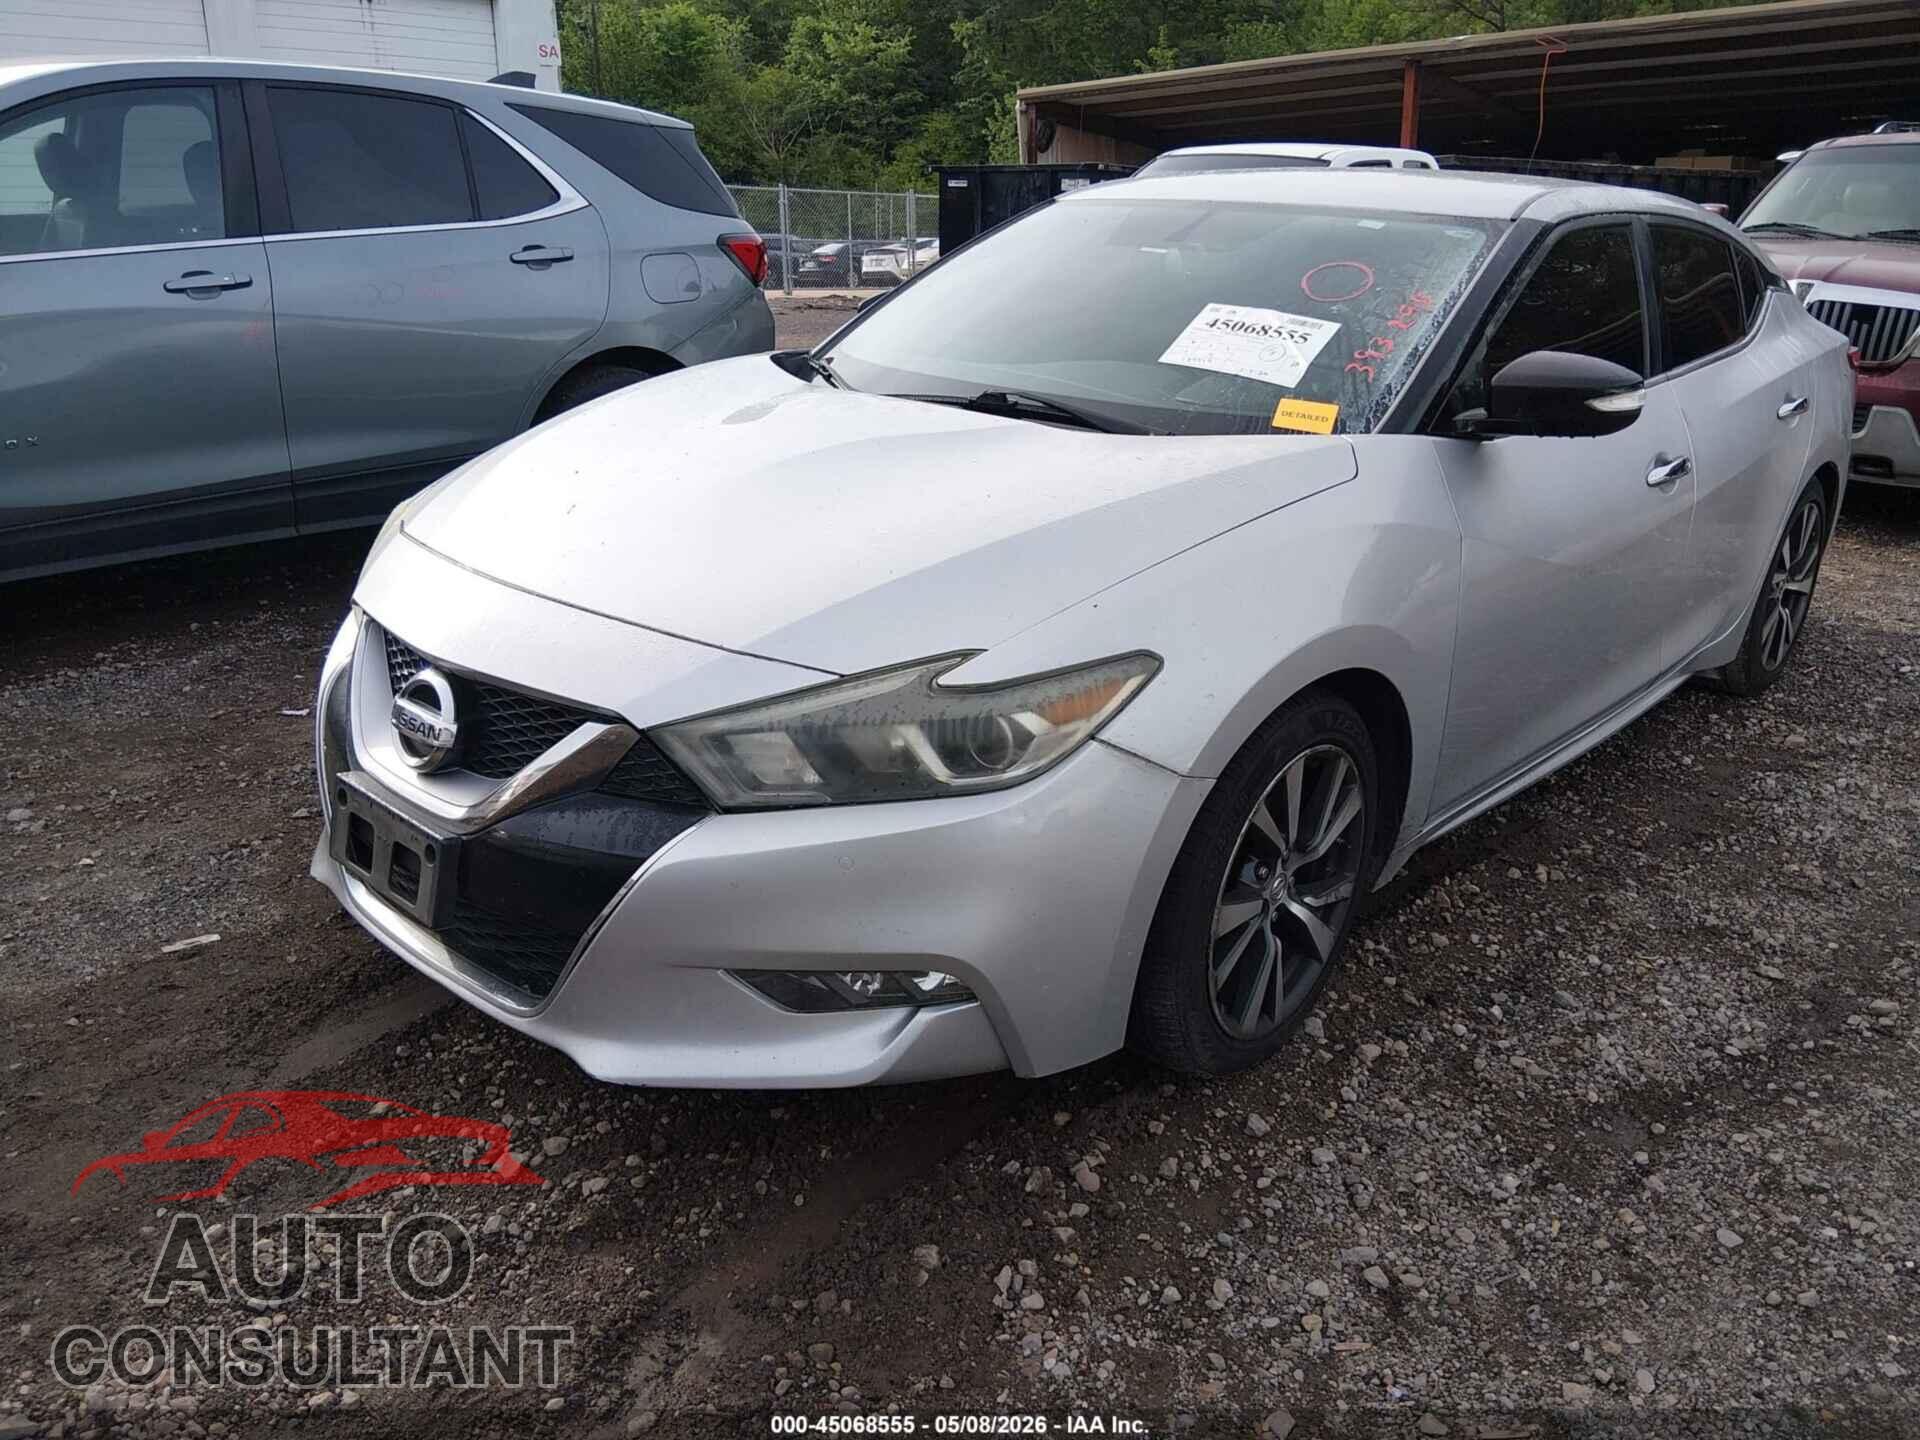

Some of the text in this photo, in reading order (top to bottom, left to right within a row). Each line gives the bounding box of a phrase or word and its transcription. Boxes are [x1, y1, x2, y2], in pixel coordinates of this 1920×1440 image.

[538, 44, 559, 58] SA
[1205, 317, 1312, 345] 45068555
[1280, 409, 1329, 424] DETAILED
[392, 705, 442, 743] ISSAN
